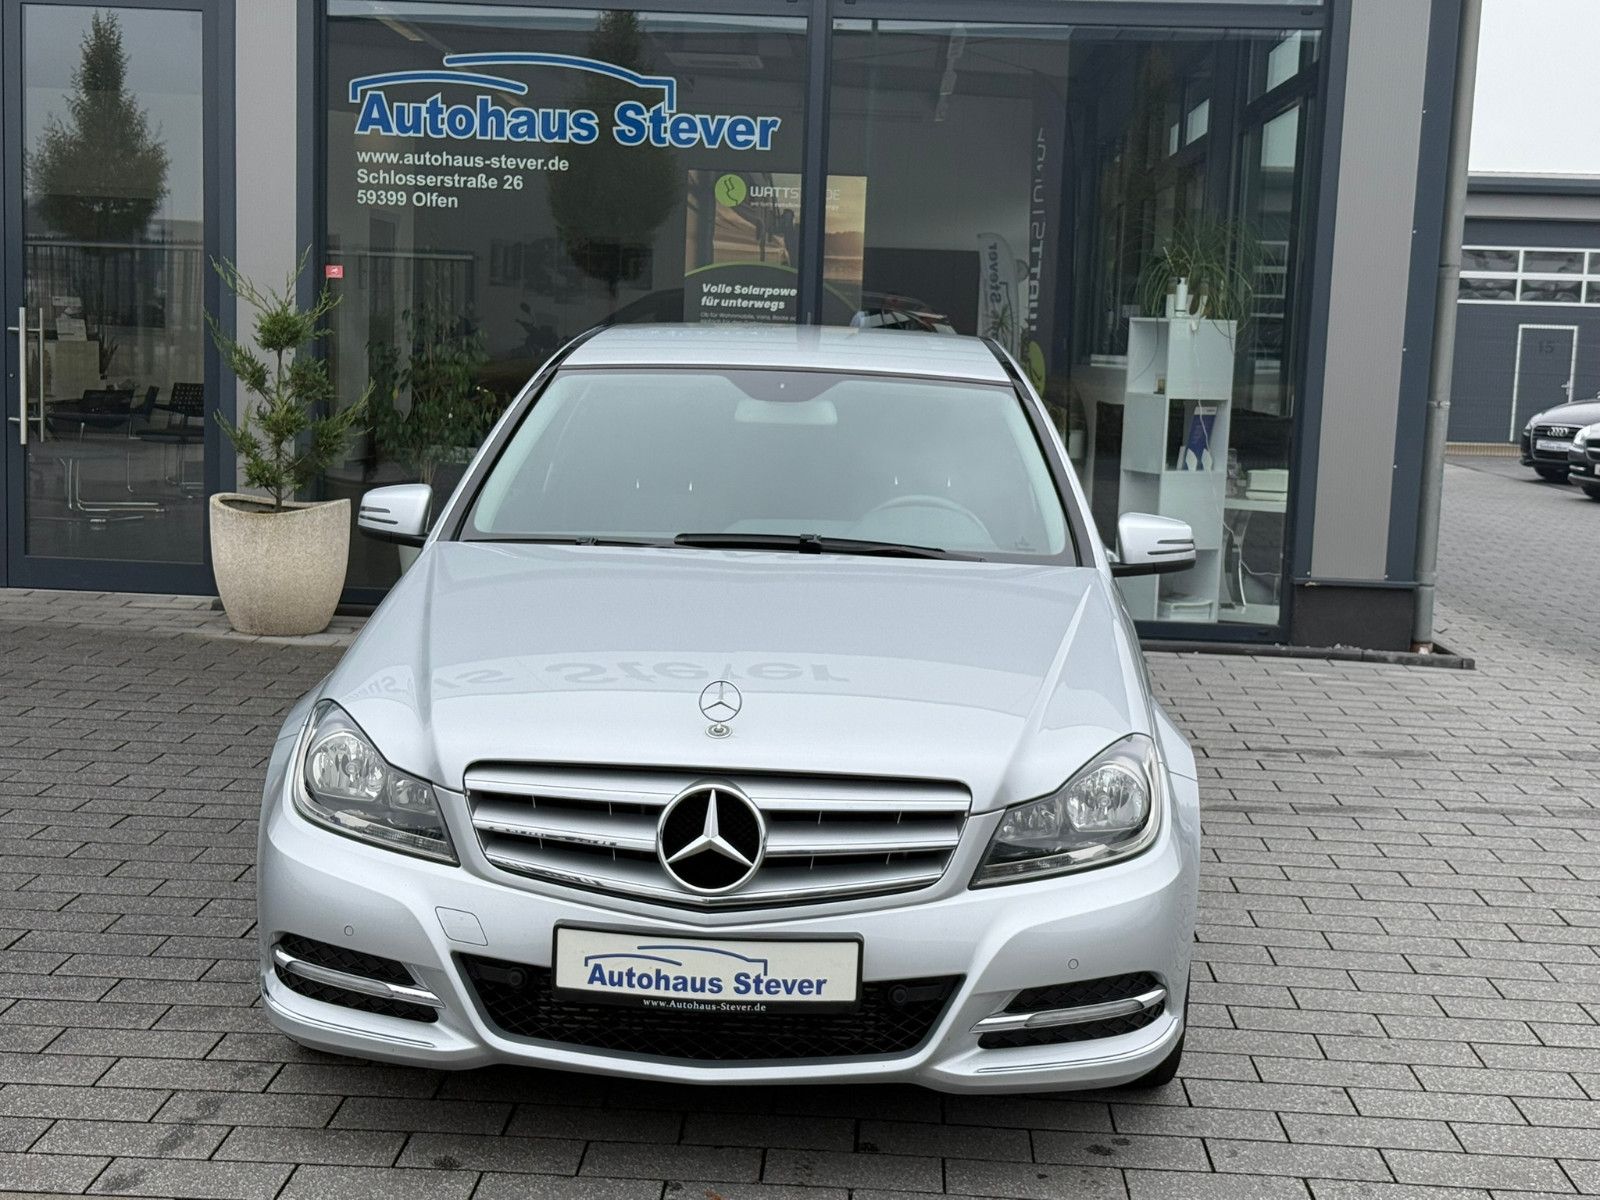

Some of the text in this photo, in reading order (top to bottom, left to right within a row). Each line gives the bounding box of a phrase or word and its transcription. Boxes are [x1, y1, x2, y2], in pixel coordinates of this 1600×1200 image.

[354, 91, 781, 150] Autohaus Stever
[357, 151, 569, 171] www.autohaus-stever.de
[357, 169, 523, 190] Schlosserstraße 26
[357, 190, 459, 208] 59399 Olfen
[702, 283, 798, 298] Volle Solarpowe
[701, 295, 785, 312] für unterwegs
[587, 963, 828, 996] Autohaus Stever
[643, 998, 767, 1012] www.Autohaus-Stever.de
